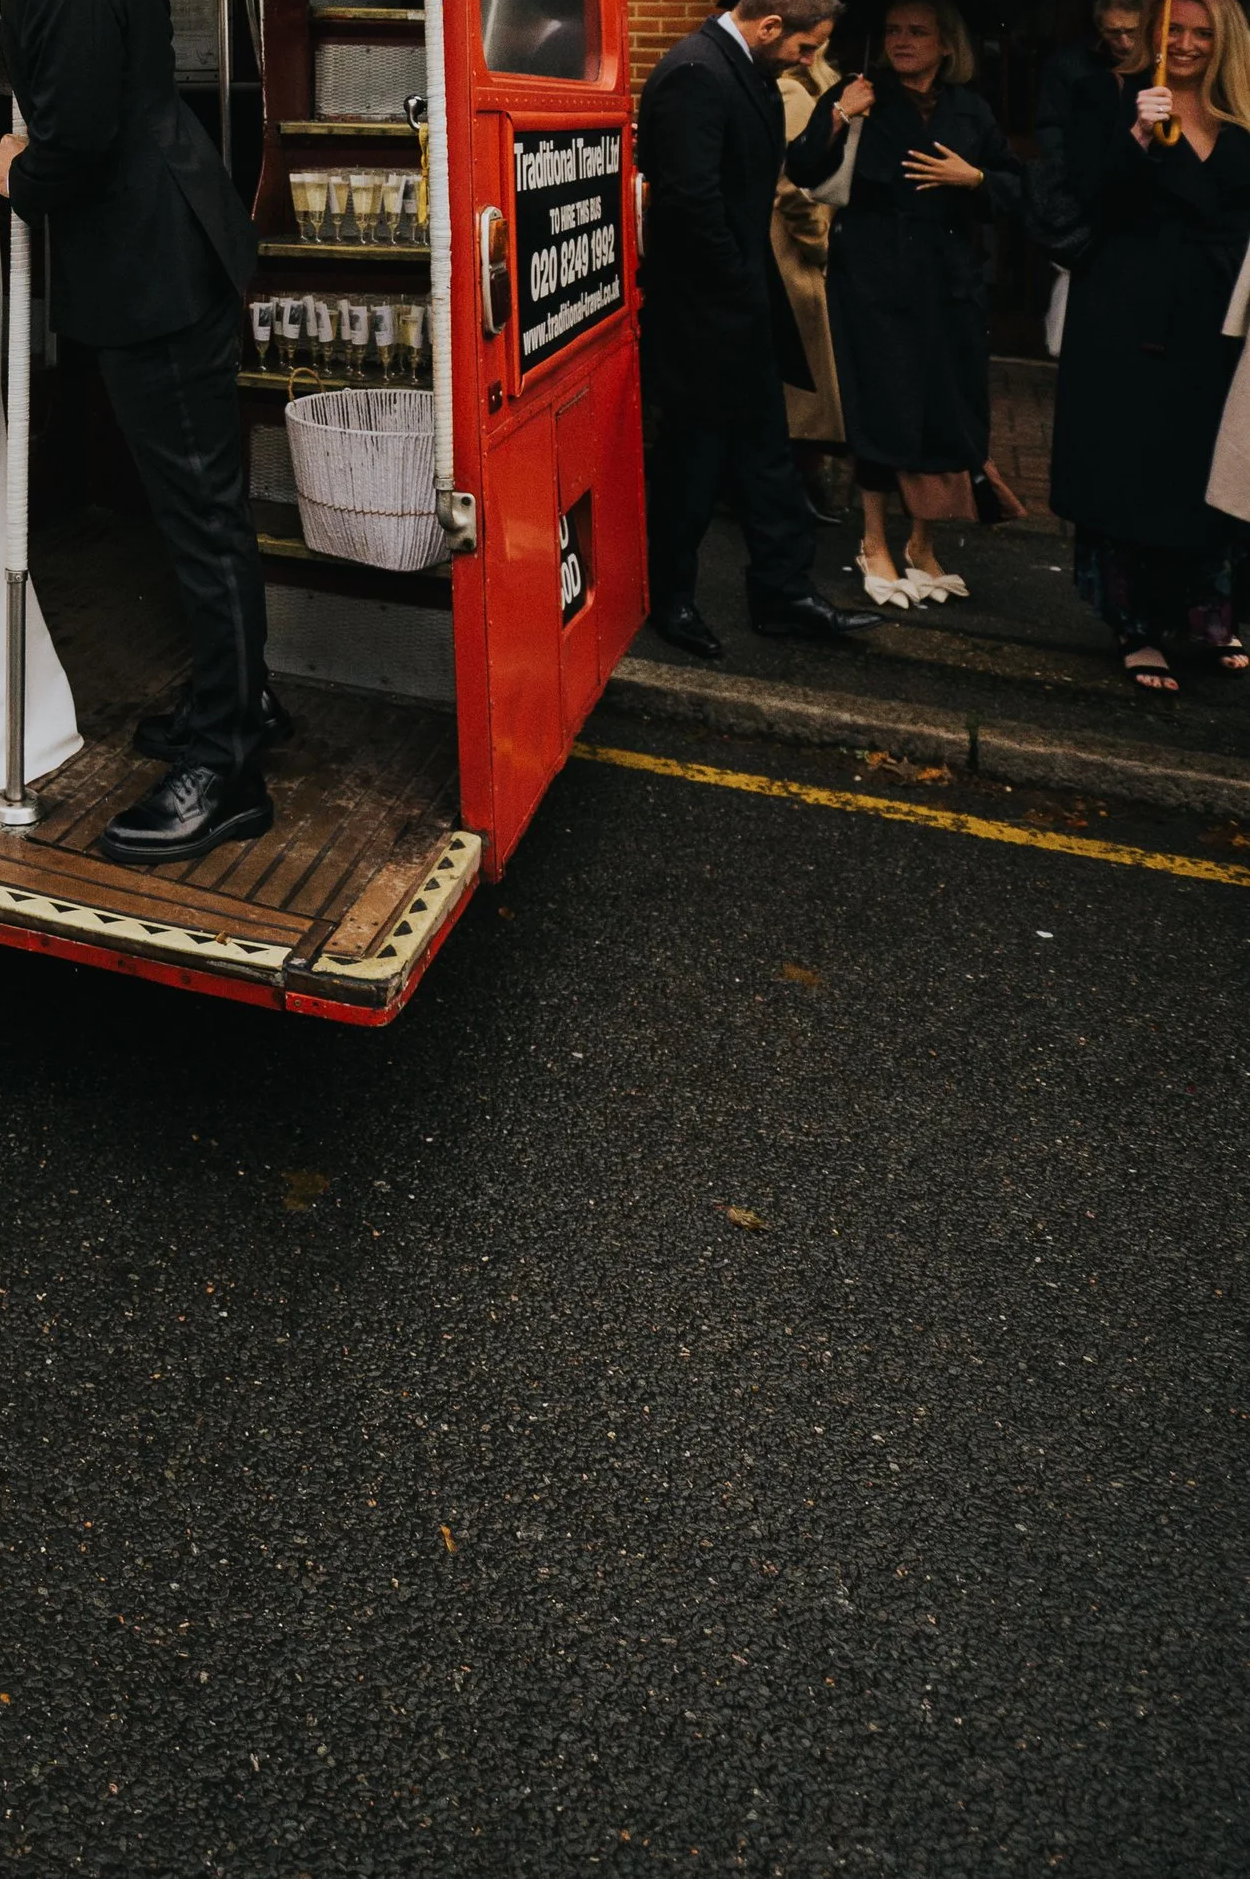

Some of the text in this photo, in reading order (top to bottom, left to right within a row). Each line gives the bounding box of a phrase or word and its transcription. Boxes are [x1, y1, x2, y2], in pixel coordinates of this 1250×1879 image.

[513, 135, 620, 192] Traditional Travel Ltd
[550, 195, 602, 235] TO HIRE THIS BUS
[531, 223, 615, 302] 020 8249 1992
[523, 274, 620, 356] www.traditional-travel.co.uk
